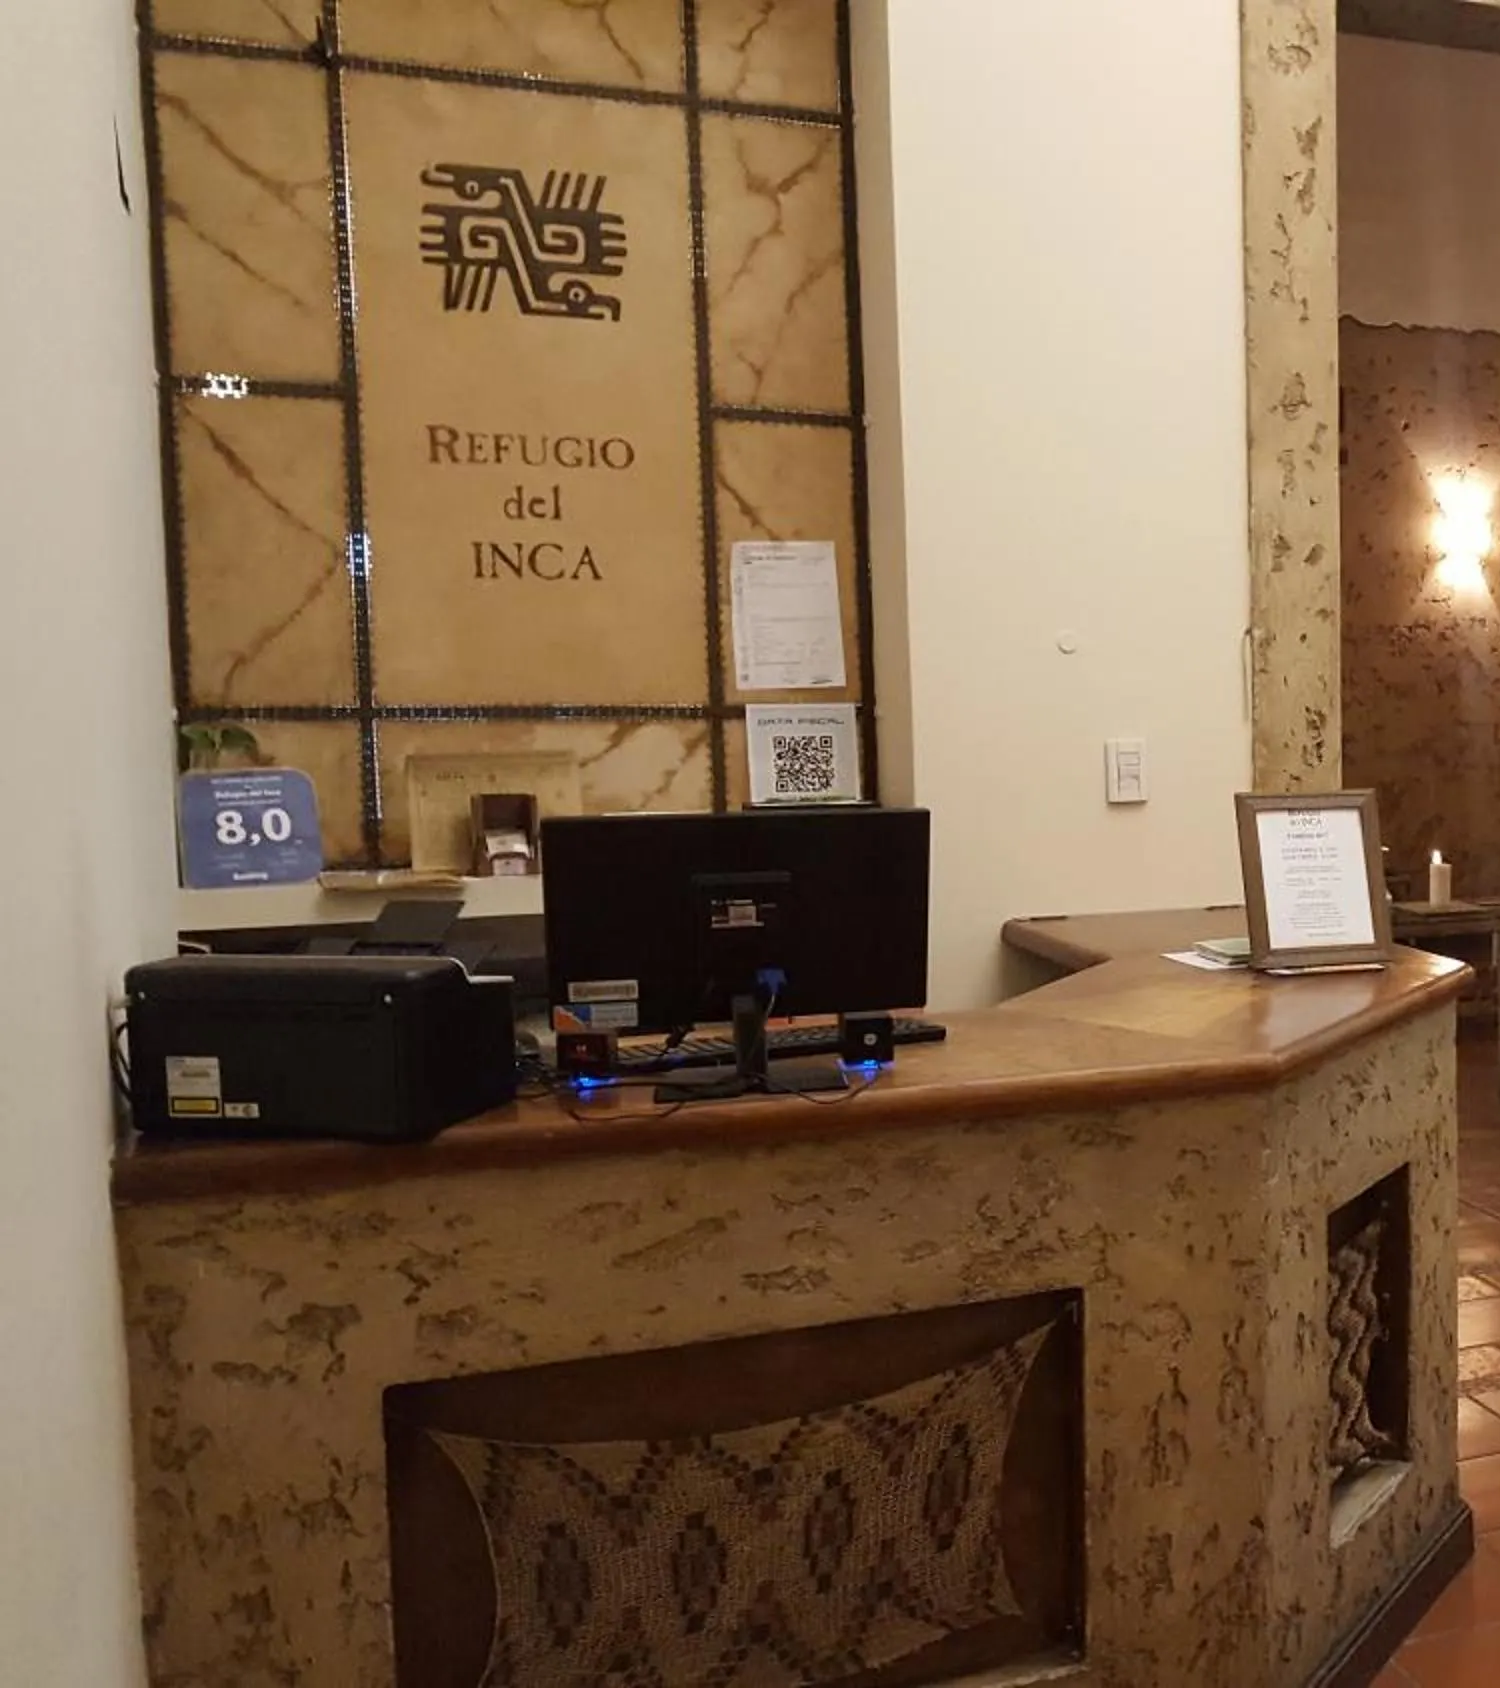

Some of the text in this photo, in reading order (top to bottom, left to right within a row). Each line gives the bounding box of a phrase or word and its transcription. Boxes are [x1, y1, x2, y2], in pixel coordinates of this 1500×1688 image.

[425, 424, 635, 469] REFUGIO
[503, 485, 562, 520] del
[471, 541, 602, 580] INCA
[215, 808, 291, 846] 8,0
